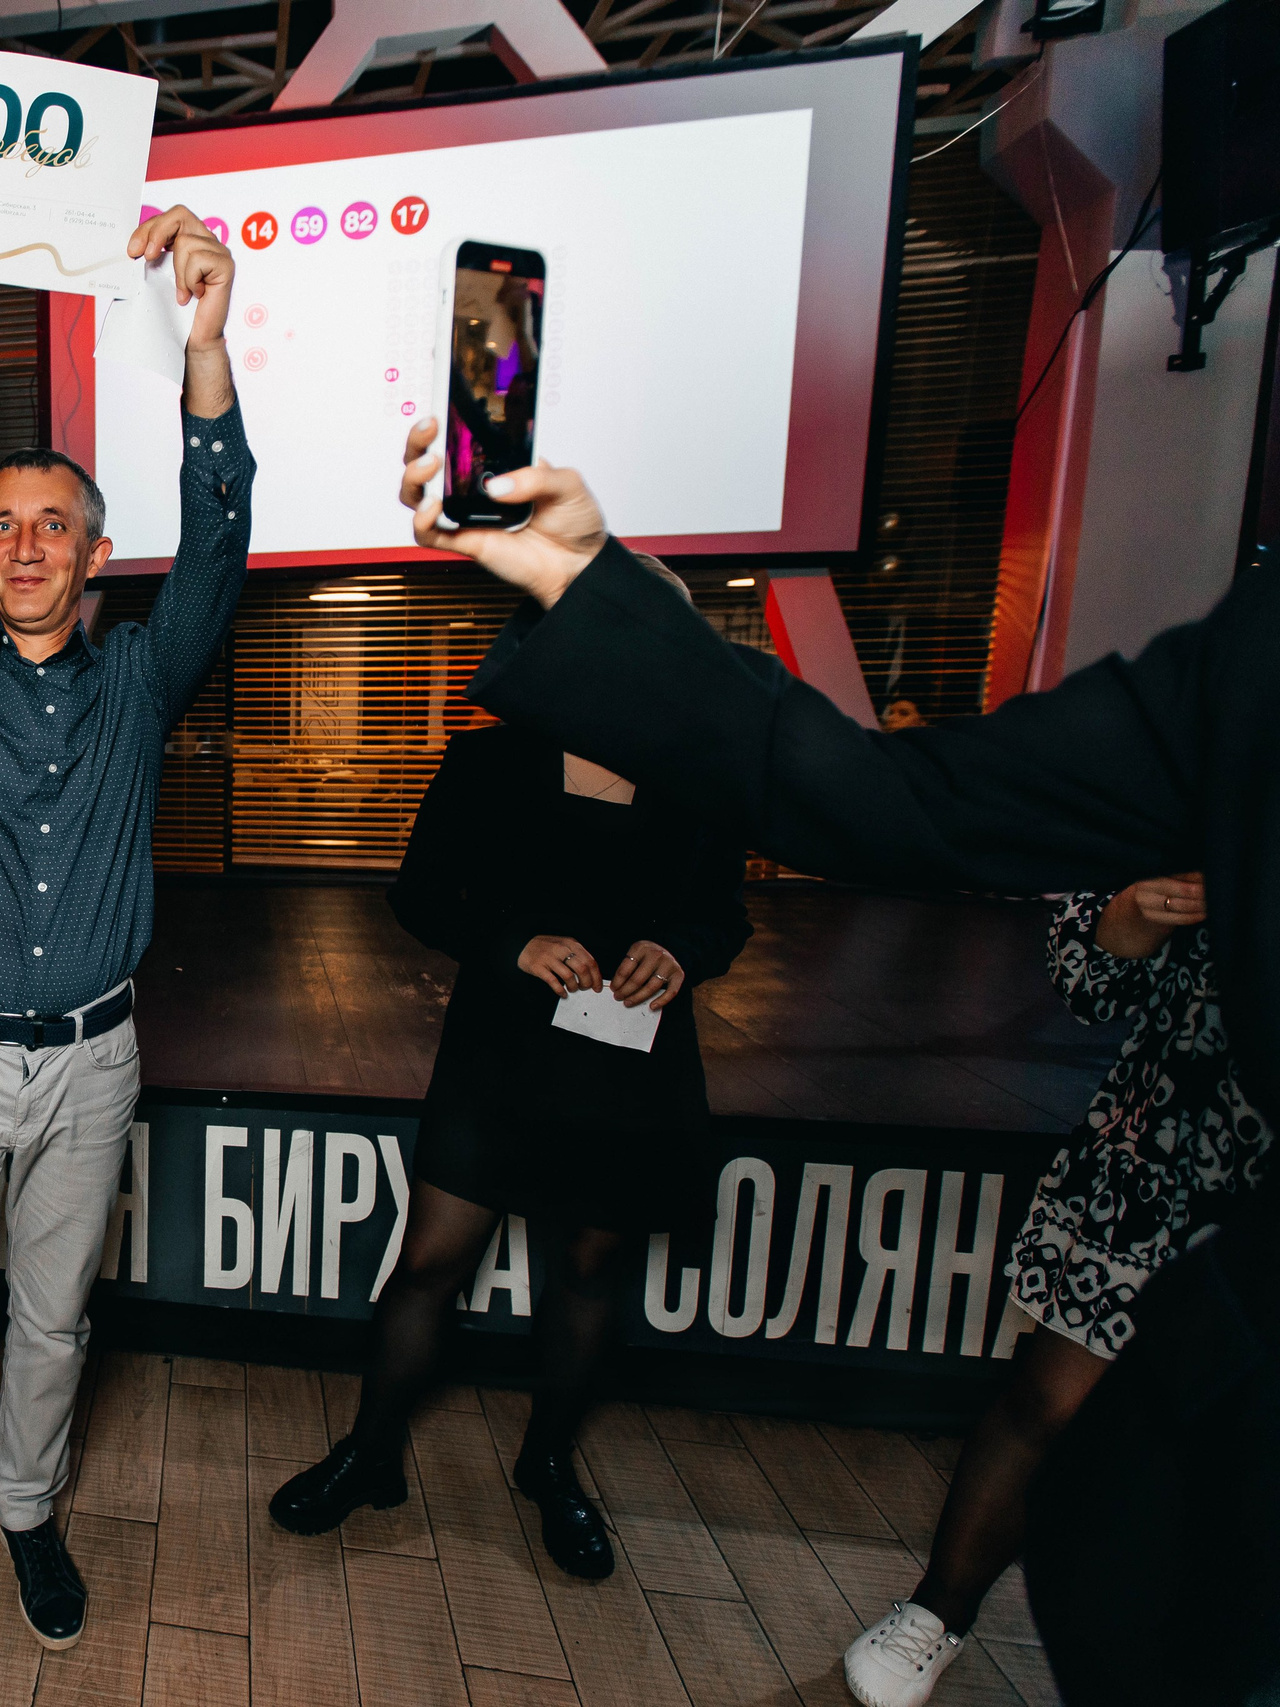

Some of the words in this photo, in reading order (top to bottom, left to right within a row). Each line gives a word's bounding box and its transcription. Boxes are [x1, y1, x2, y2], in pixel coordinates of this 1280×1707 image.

[64, 208, 96, 219] 261-04-44
[69, 217, 84, 225] (929)
[85, 218, 116, 229] 044-98-10
[247, 220, 274, 242] 14
[294, 214, 322, 238] 59
[344, 209, 374, 234] 82
[396, 204, 425, 227] 17
[643, 1156, 1038, 1360] СОЛЯН
